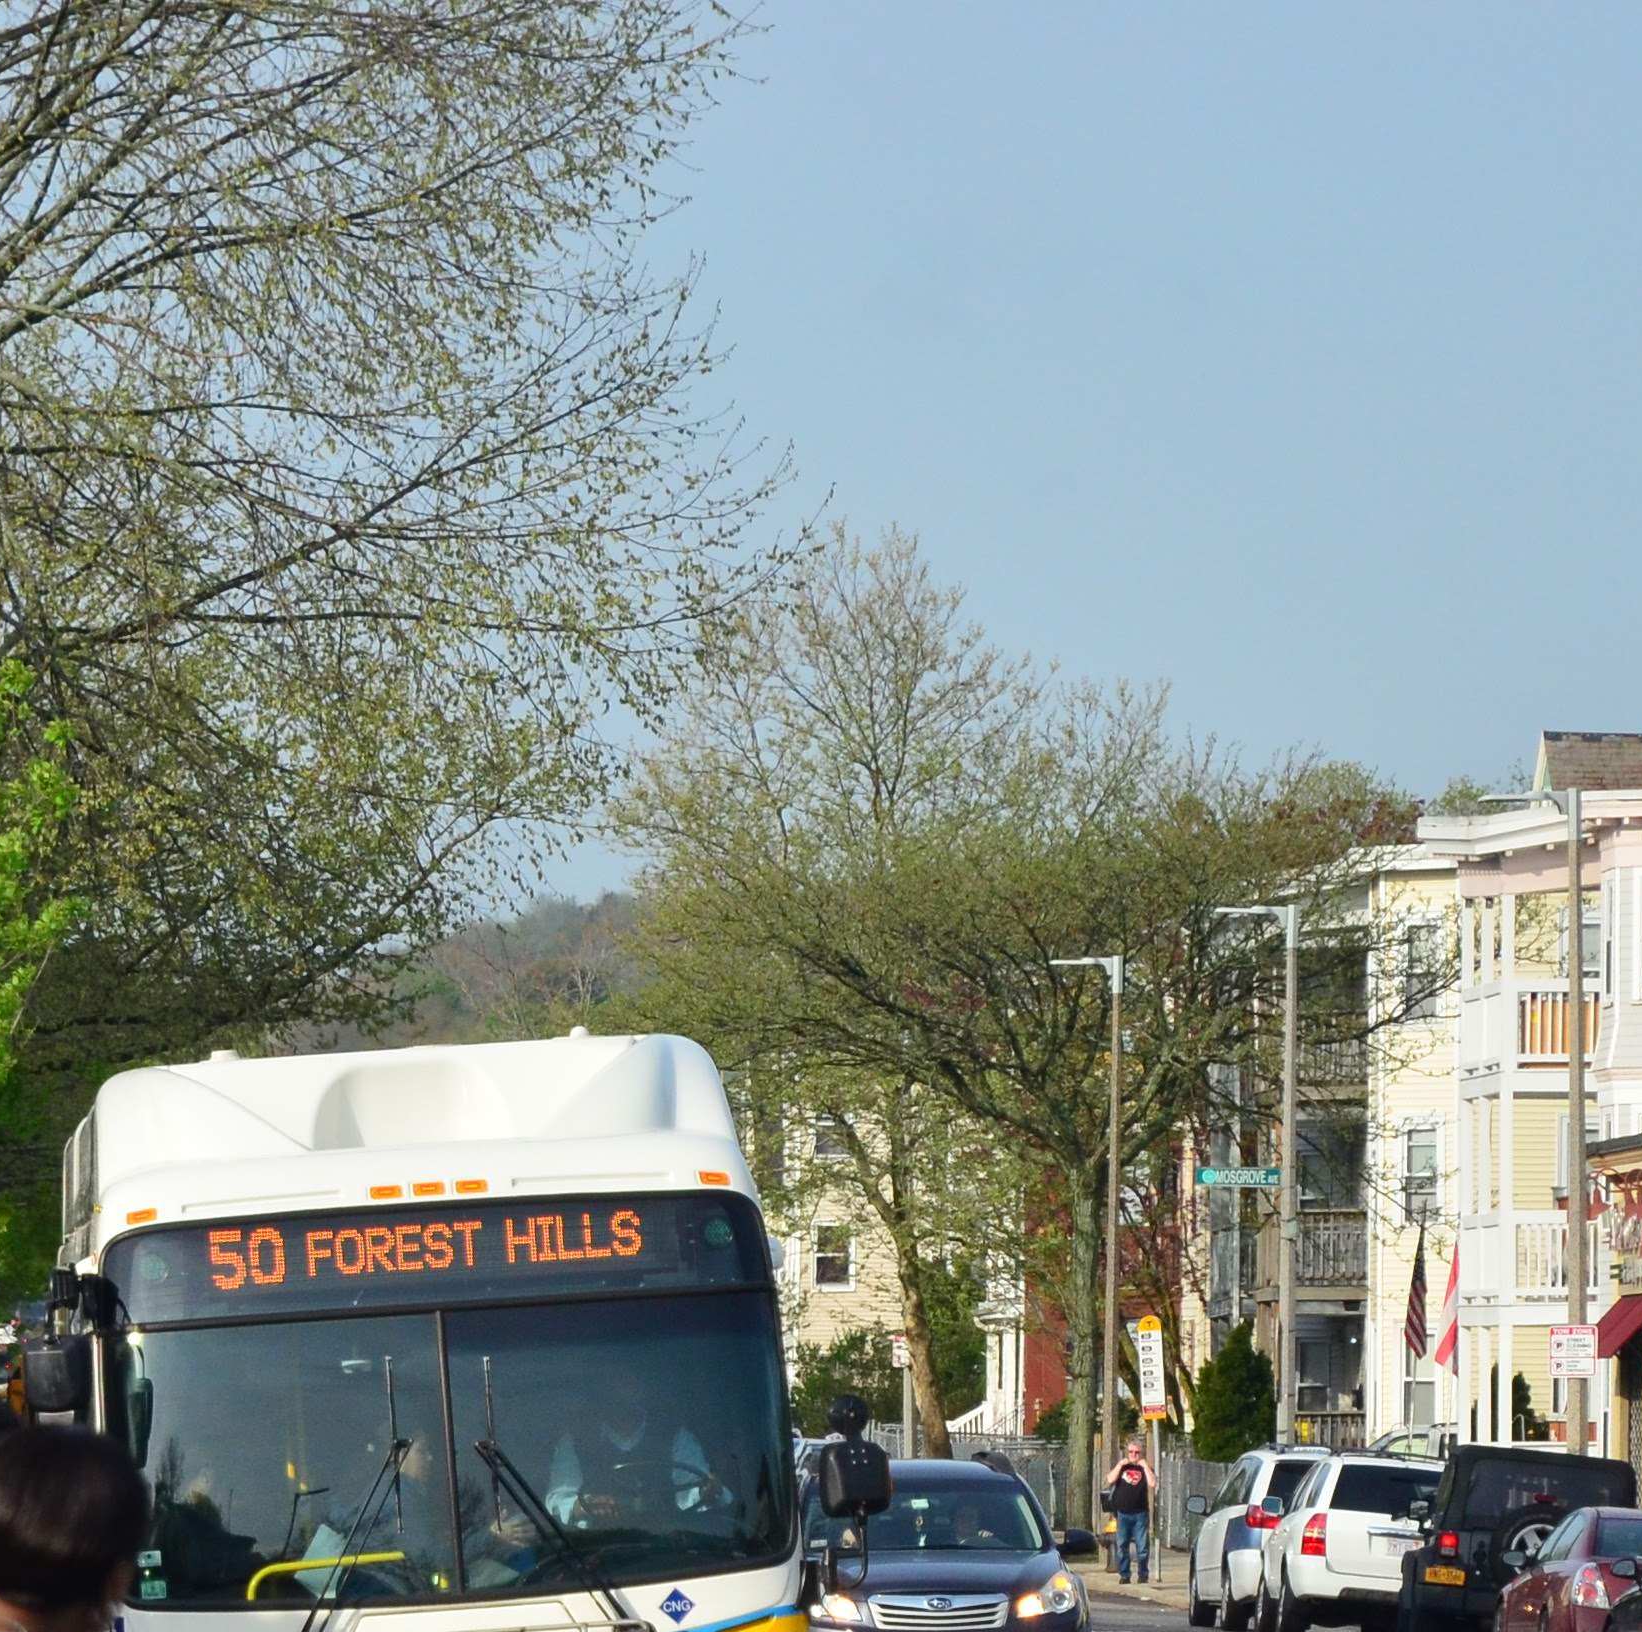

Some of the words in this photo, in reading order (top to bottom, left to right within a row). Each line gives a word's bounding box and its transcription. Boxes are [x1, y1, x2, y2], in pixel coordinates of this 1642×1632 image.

[1217, 1170, 1266, 1184] MOSGROVE
[208, 1226, 286, 1290] 50
[305, 1220, 483, 1277] FOREST
[504, 1210, 643, 1265] HILLS
[663, 1600, 691, 1613] CNG
